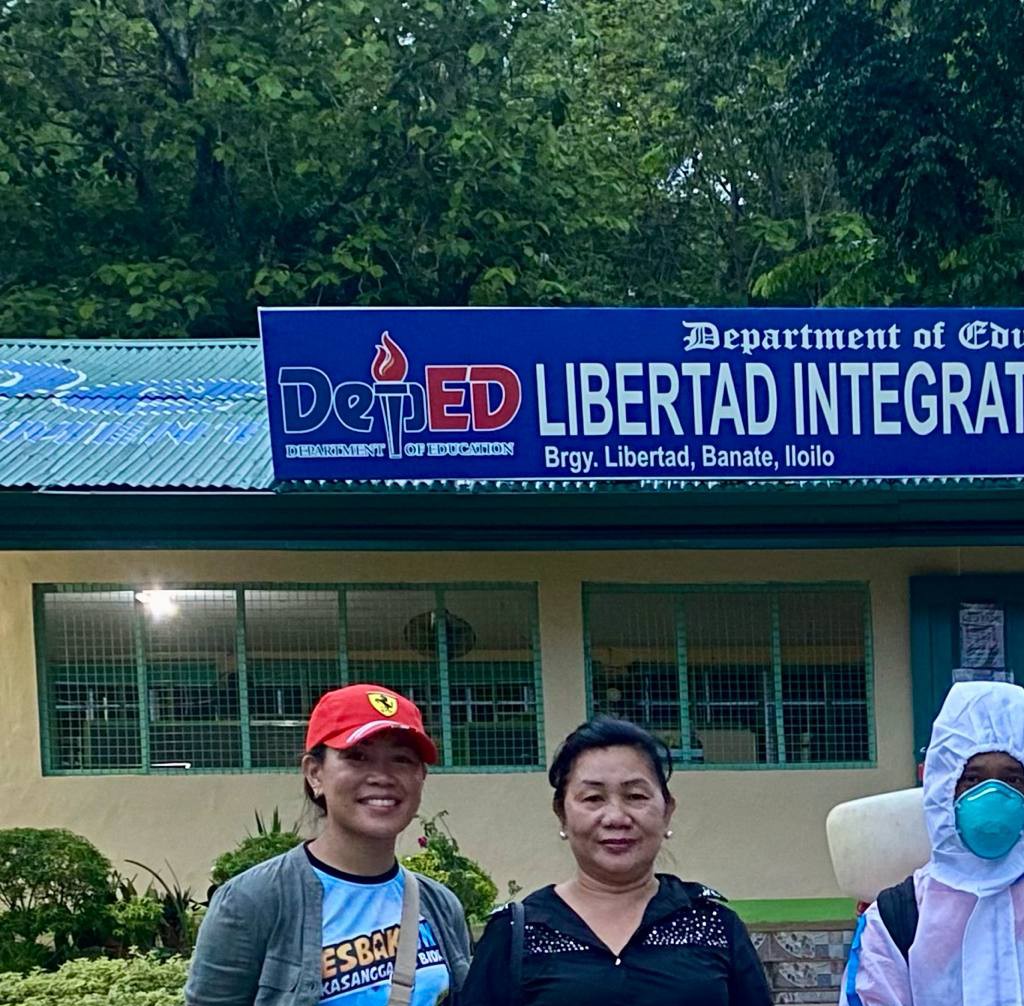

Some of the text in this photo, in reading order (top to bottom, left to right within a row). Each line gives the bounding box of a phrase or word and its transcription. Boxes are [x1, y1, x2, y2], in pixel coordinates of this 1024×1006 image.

[682, 320, 901, 354] Department
[913, 321, 945, 350] of
[278, 364, 522, 434] DepED
[536, 362, 778, 436] LIBERTAD
[285, 441, 515, 459] DEPARTMENT OF EDUCATION
[544, 445, 835, 473] Brgy. Libertad, Banate, Iloilo
